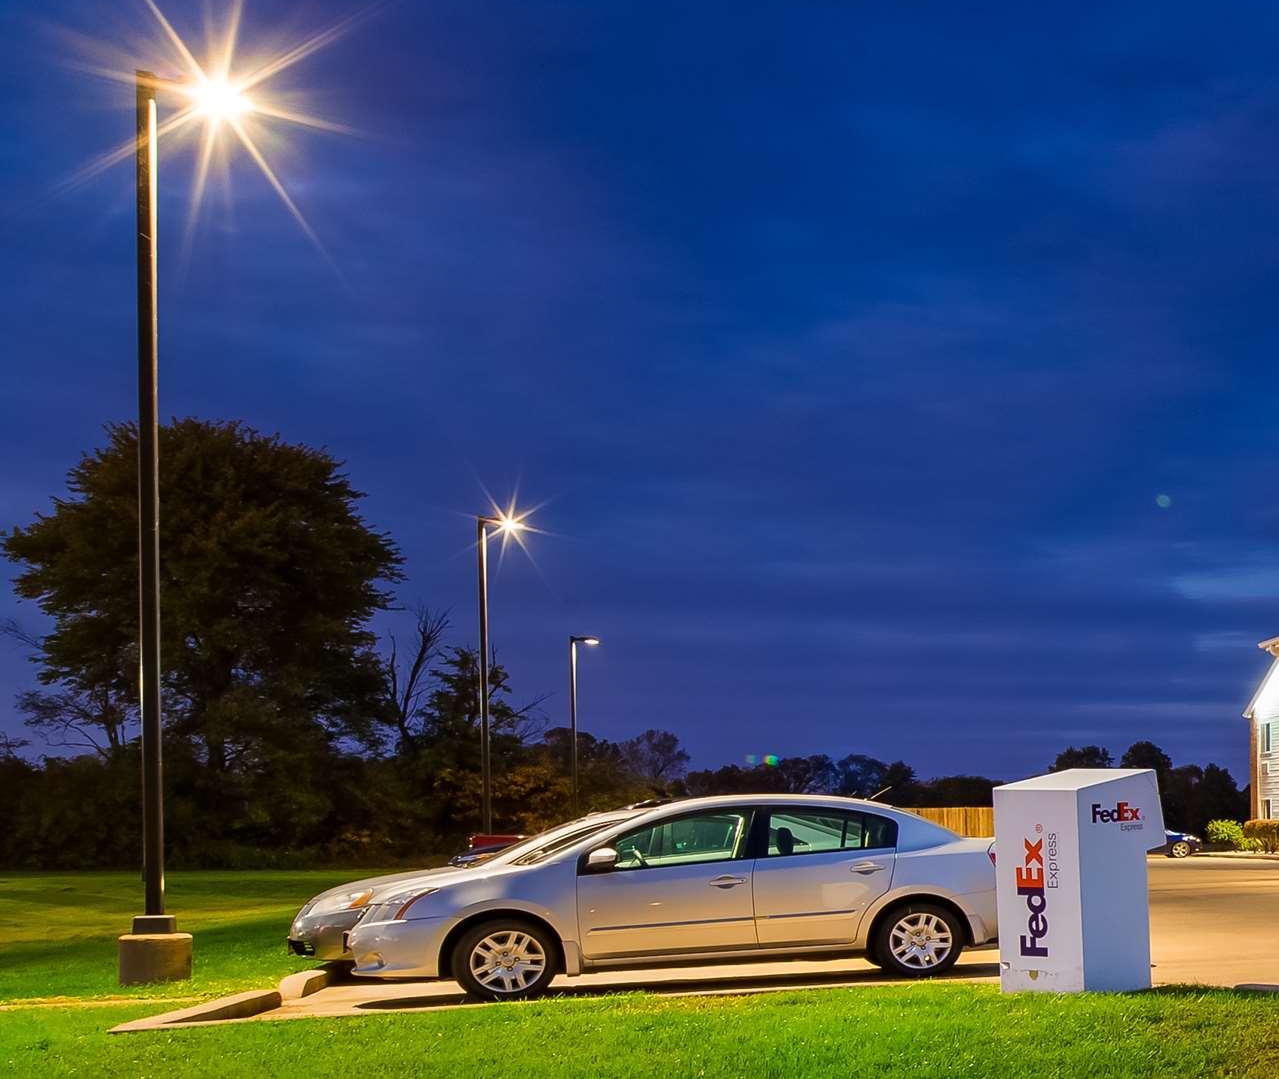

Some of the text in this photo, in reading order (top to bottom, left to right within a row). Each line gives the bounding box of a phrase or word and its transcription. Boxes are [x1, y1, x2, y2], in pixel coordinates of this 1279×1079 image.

[1091, 802, 1140, 824] FedEx
[1119, 822, 1144, 832] Express
[1047, 832, 1059, 889] Express
[1016, 837, 1049, 958] FedEx
